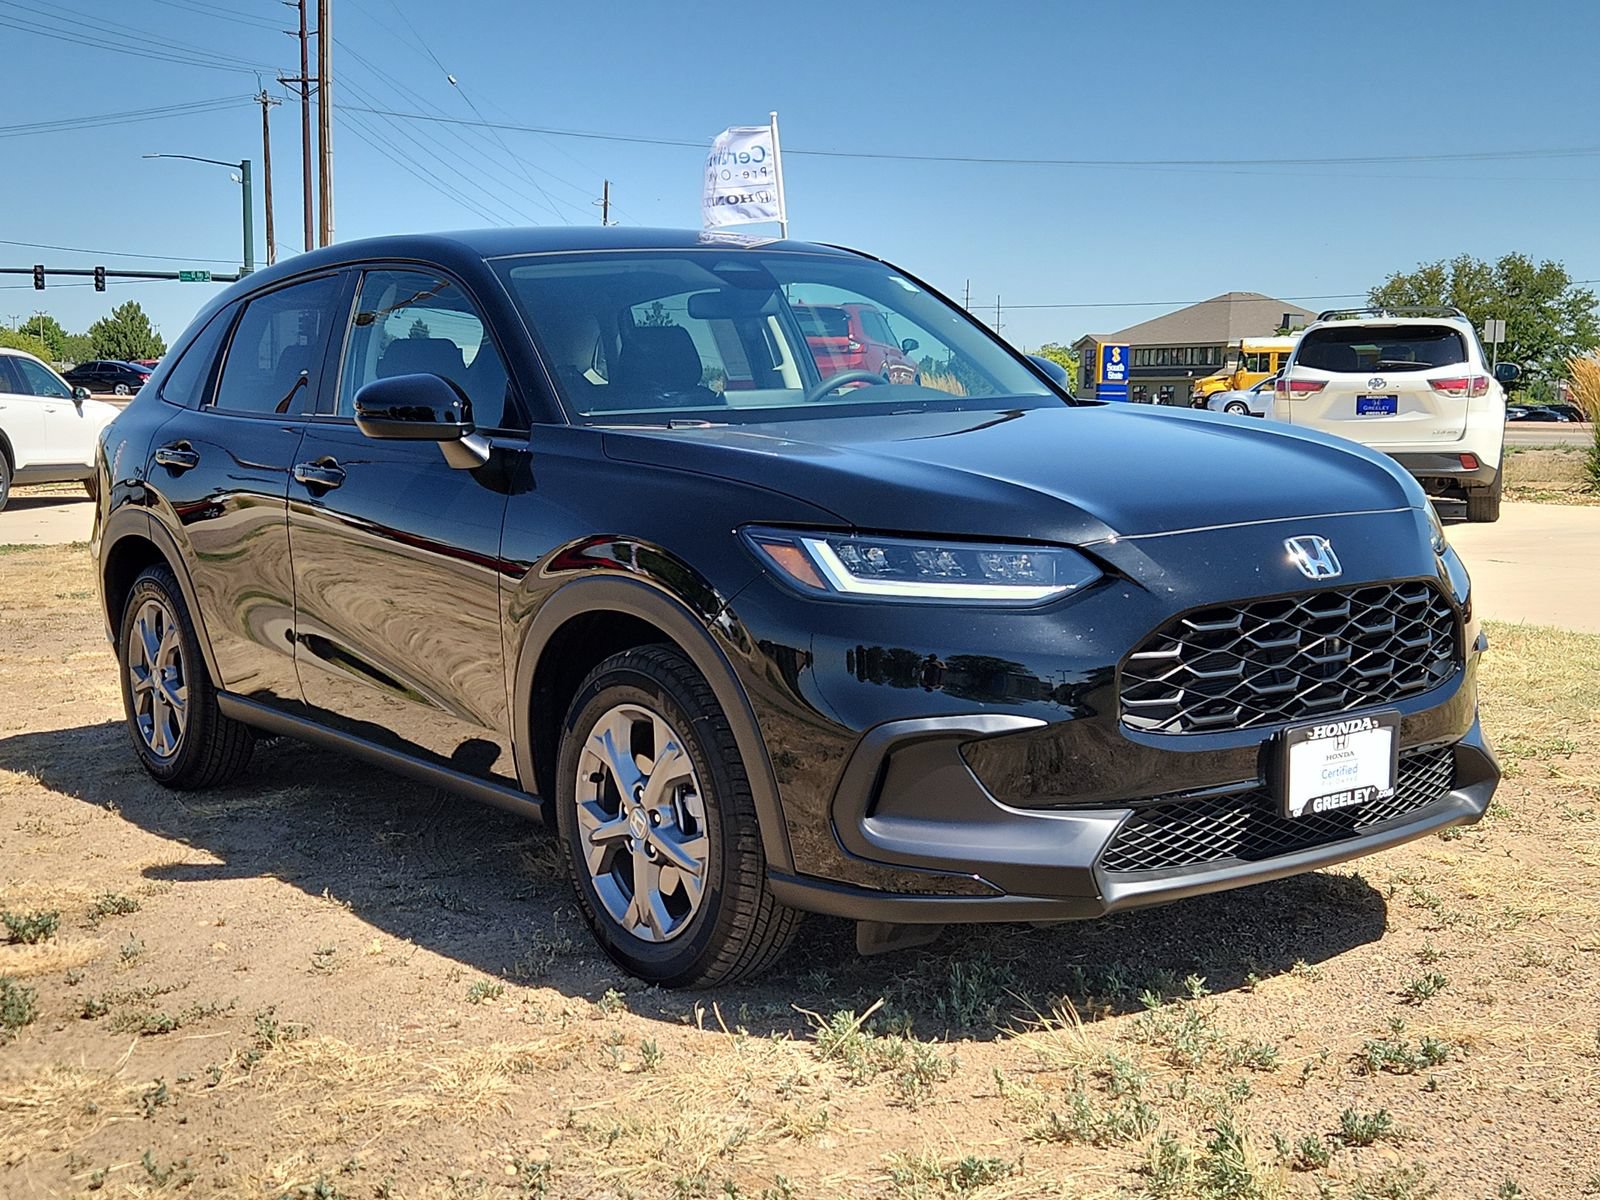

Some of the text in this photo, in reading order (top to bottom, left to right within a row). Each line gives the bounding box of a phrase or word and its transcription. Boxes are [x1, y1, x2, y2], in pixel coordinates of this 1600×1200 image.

[1311, 717, 1373, 739] HONDA
[679, 720, 715, 804] MICHELIN
[1326, 751, 1355, 761] HONDA
[1321, 763, 1358, 780] Certified
[1313, 787, 1371, 813] GREELEY
